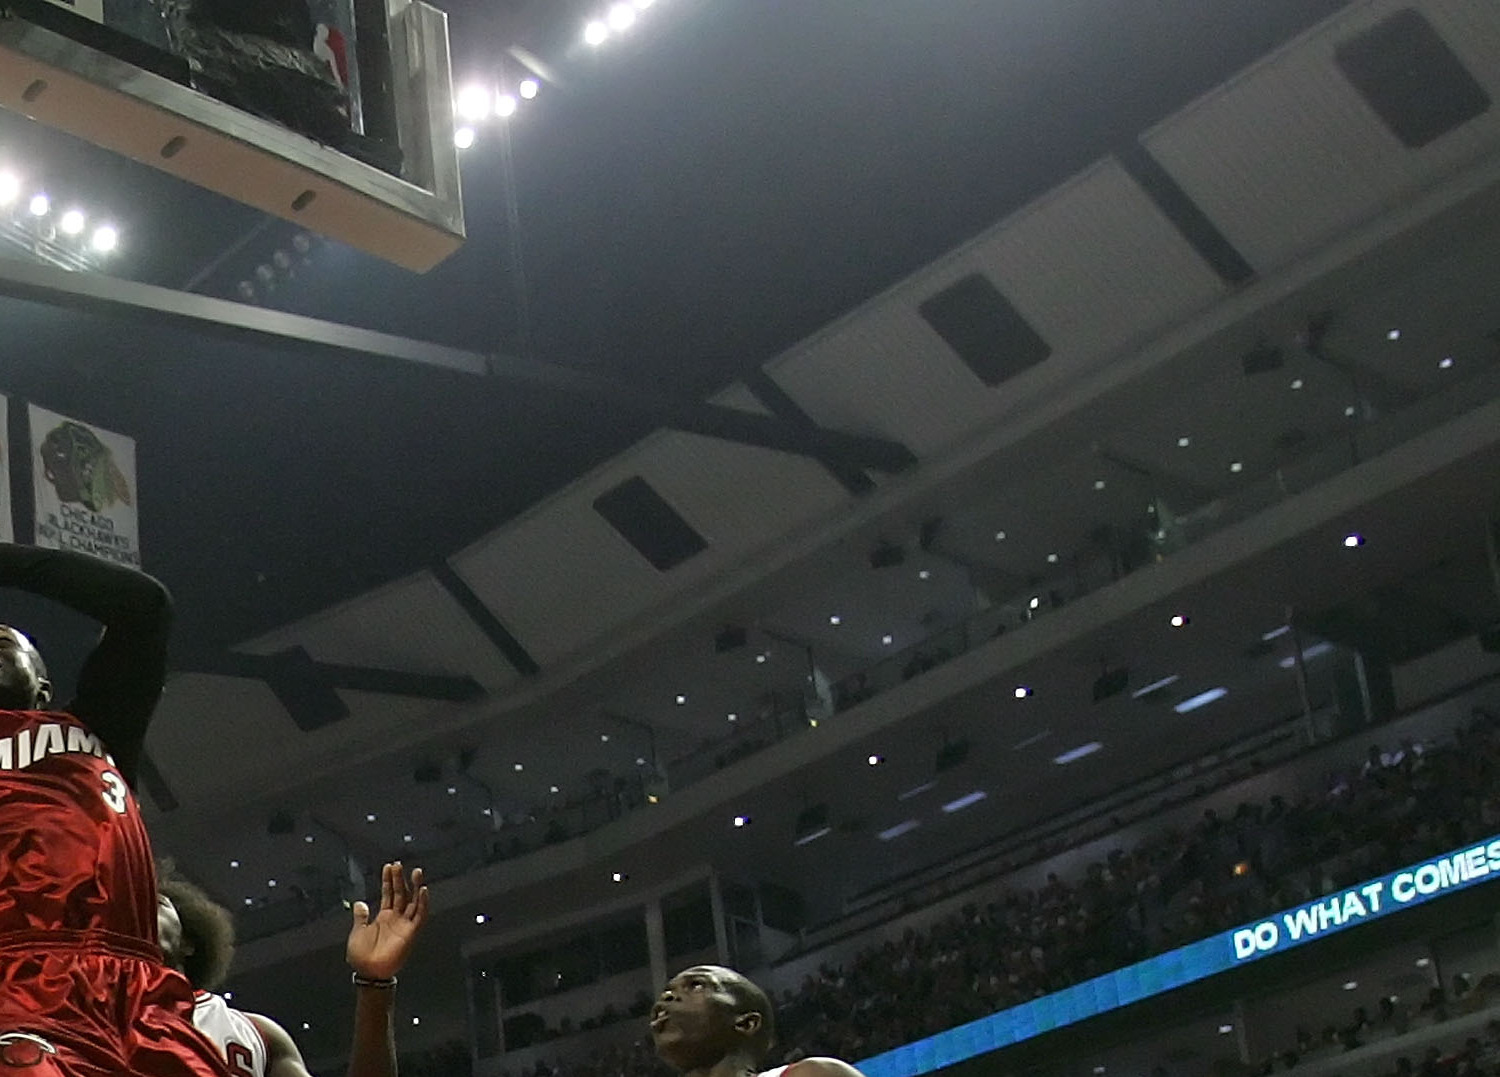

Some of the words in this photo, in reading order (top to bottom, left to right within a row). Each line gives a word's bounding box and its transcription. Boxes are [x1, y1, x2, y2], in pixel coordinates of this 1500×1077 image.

[60, 503, 114, 530] CHICAGO
[100, 770, 126, 814] 3
[1233, 922, 1278, 959] DO
[1284, 882, 1382, 940] WHAT
[1391, 841, 1500, 904] COMES
